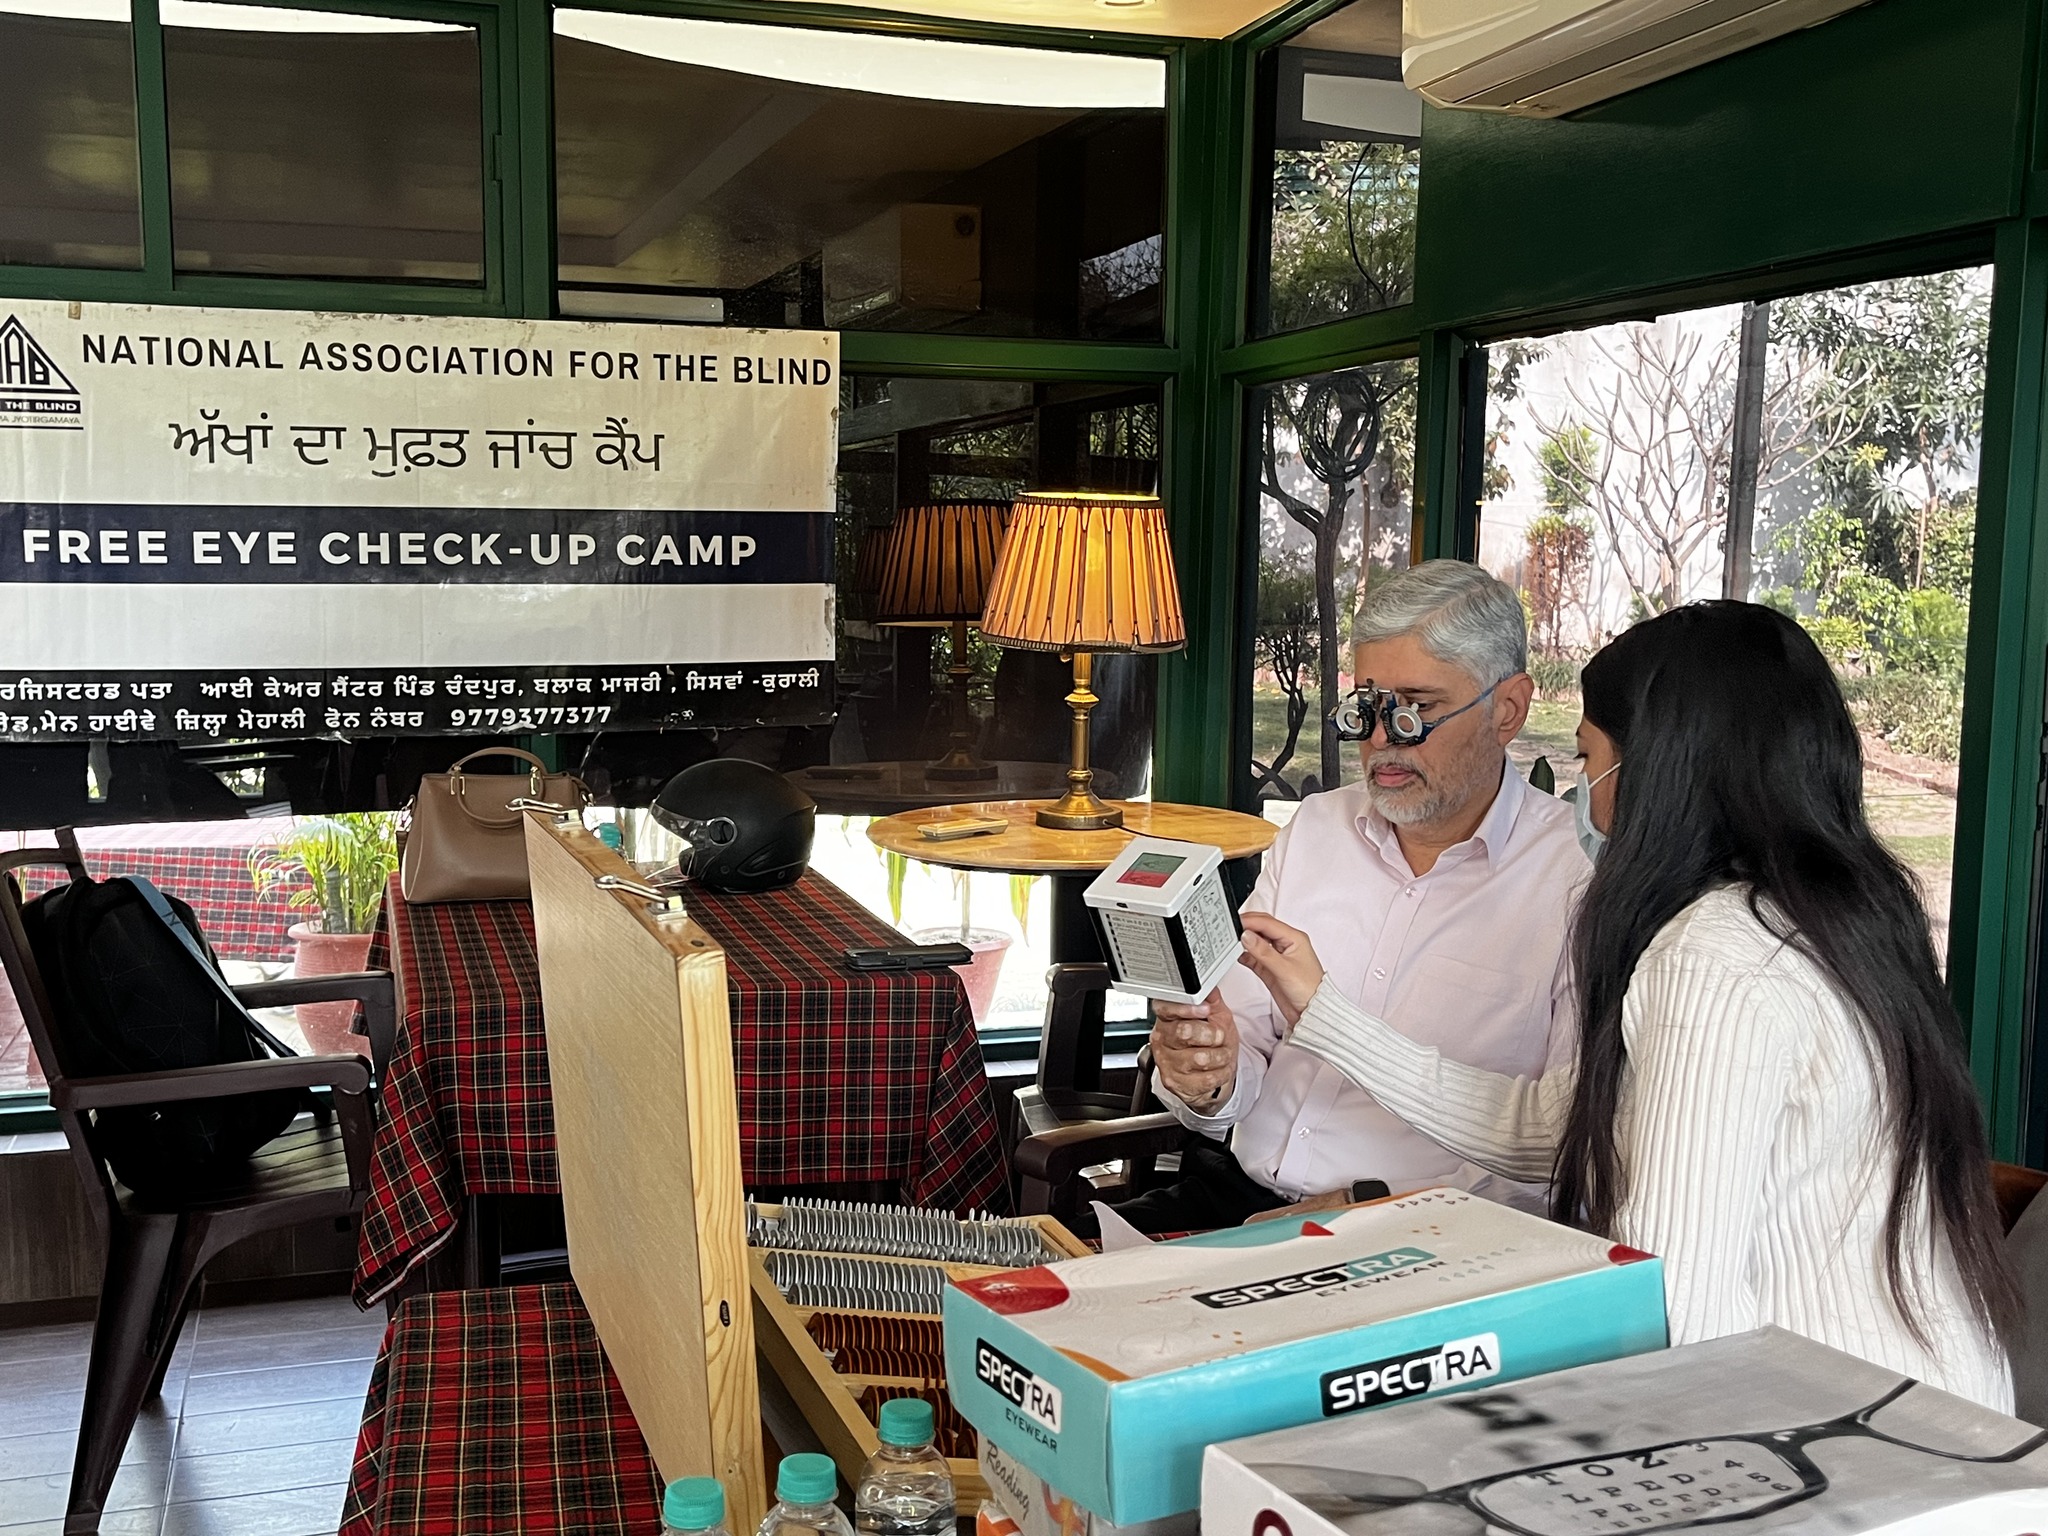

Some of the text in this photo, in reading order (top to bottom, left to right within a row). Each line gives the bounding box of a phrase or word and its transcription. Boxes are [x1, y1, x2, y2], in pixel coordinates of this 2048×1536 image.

[0, 326, 50, 386] AB
[82, 333, 831, 386] NATIONAL ASSOCIATION FOR THE BLIND
[5, 401, 77, 411] THE BLIND
[168, 408, 274, 465] ਅੱਖਾਂ
[289, 425, 347, 466] ਦਾ
[485, 418, 578, 470] ਜਾਂਚ
[592, 416, 665, 472] ਕੈਂਪ
[22, 529, 756, 566] FREE EYE CHECK-UP CAMP
[0, 677, 121, 701] ਰਜਿਸਟਰਡ
[129, 682, 173, 700] ਪਤਾ
[199, 676, 254, 699] ਆਈ
[262, 676, 322, 698] ਕੇਅਰ
[331, 675, 384, 697] ਸੈਂਟਰ
[393, 674, 436, 697] ਪਿੰਡ
[444, 674, 524, 700] ਚੰਦਪੁਰ,
[533, 678, 593, 694] ਬਲਾਕ
[600, 671, 662, 693] ਮਾਜਰੀ
[685, 670, 744, 691] ਸਿਸਵਾਂ
[752, 667, 820, 693] -ਕੁਰਾਲੀ
[87, 708, 157, 732] ਹਾਈਵੇ
[237, 707, 307, 730] ਮੋਹਾਲੀ
[324, 706, 361, 728] ਫੋਨ
[369, 706, 424, 728] ਨੰਬਰ
[450, 704, 612, 727] 9779377377
[1206, 1252, 1425, 1307] SPECTRA
[1315, 1260, 1448, 1298] EYEWEAR
[979, 1347, 1057, 1426] SPECTRA
[1329, 1345, 1492, 1411] SPECTRA
[1005, 1407, 1058, 1454] EYEWEAR
[986, 1439, 1031, 1521] Reading
[1724, 1459, 1745, 1469] 4
[1746, 1472, 1772, 1484] 5
[1771, 1483, 1793, 1492] 6
